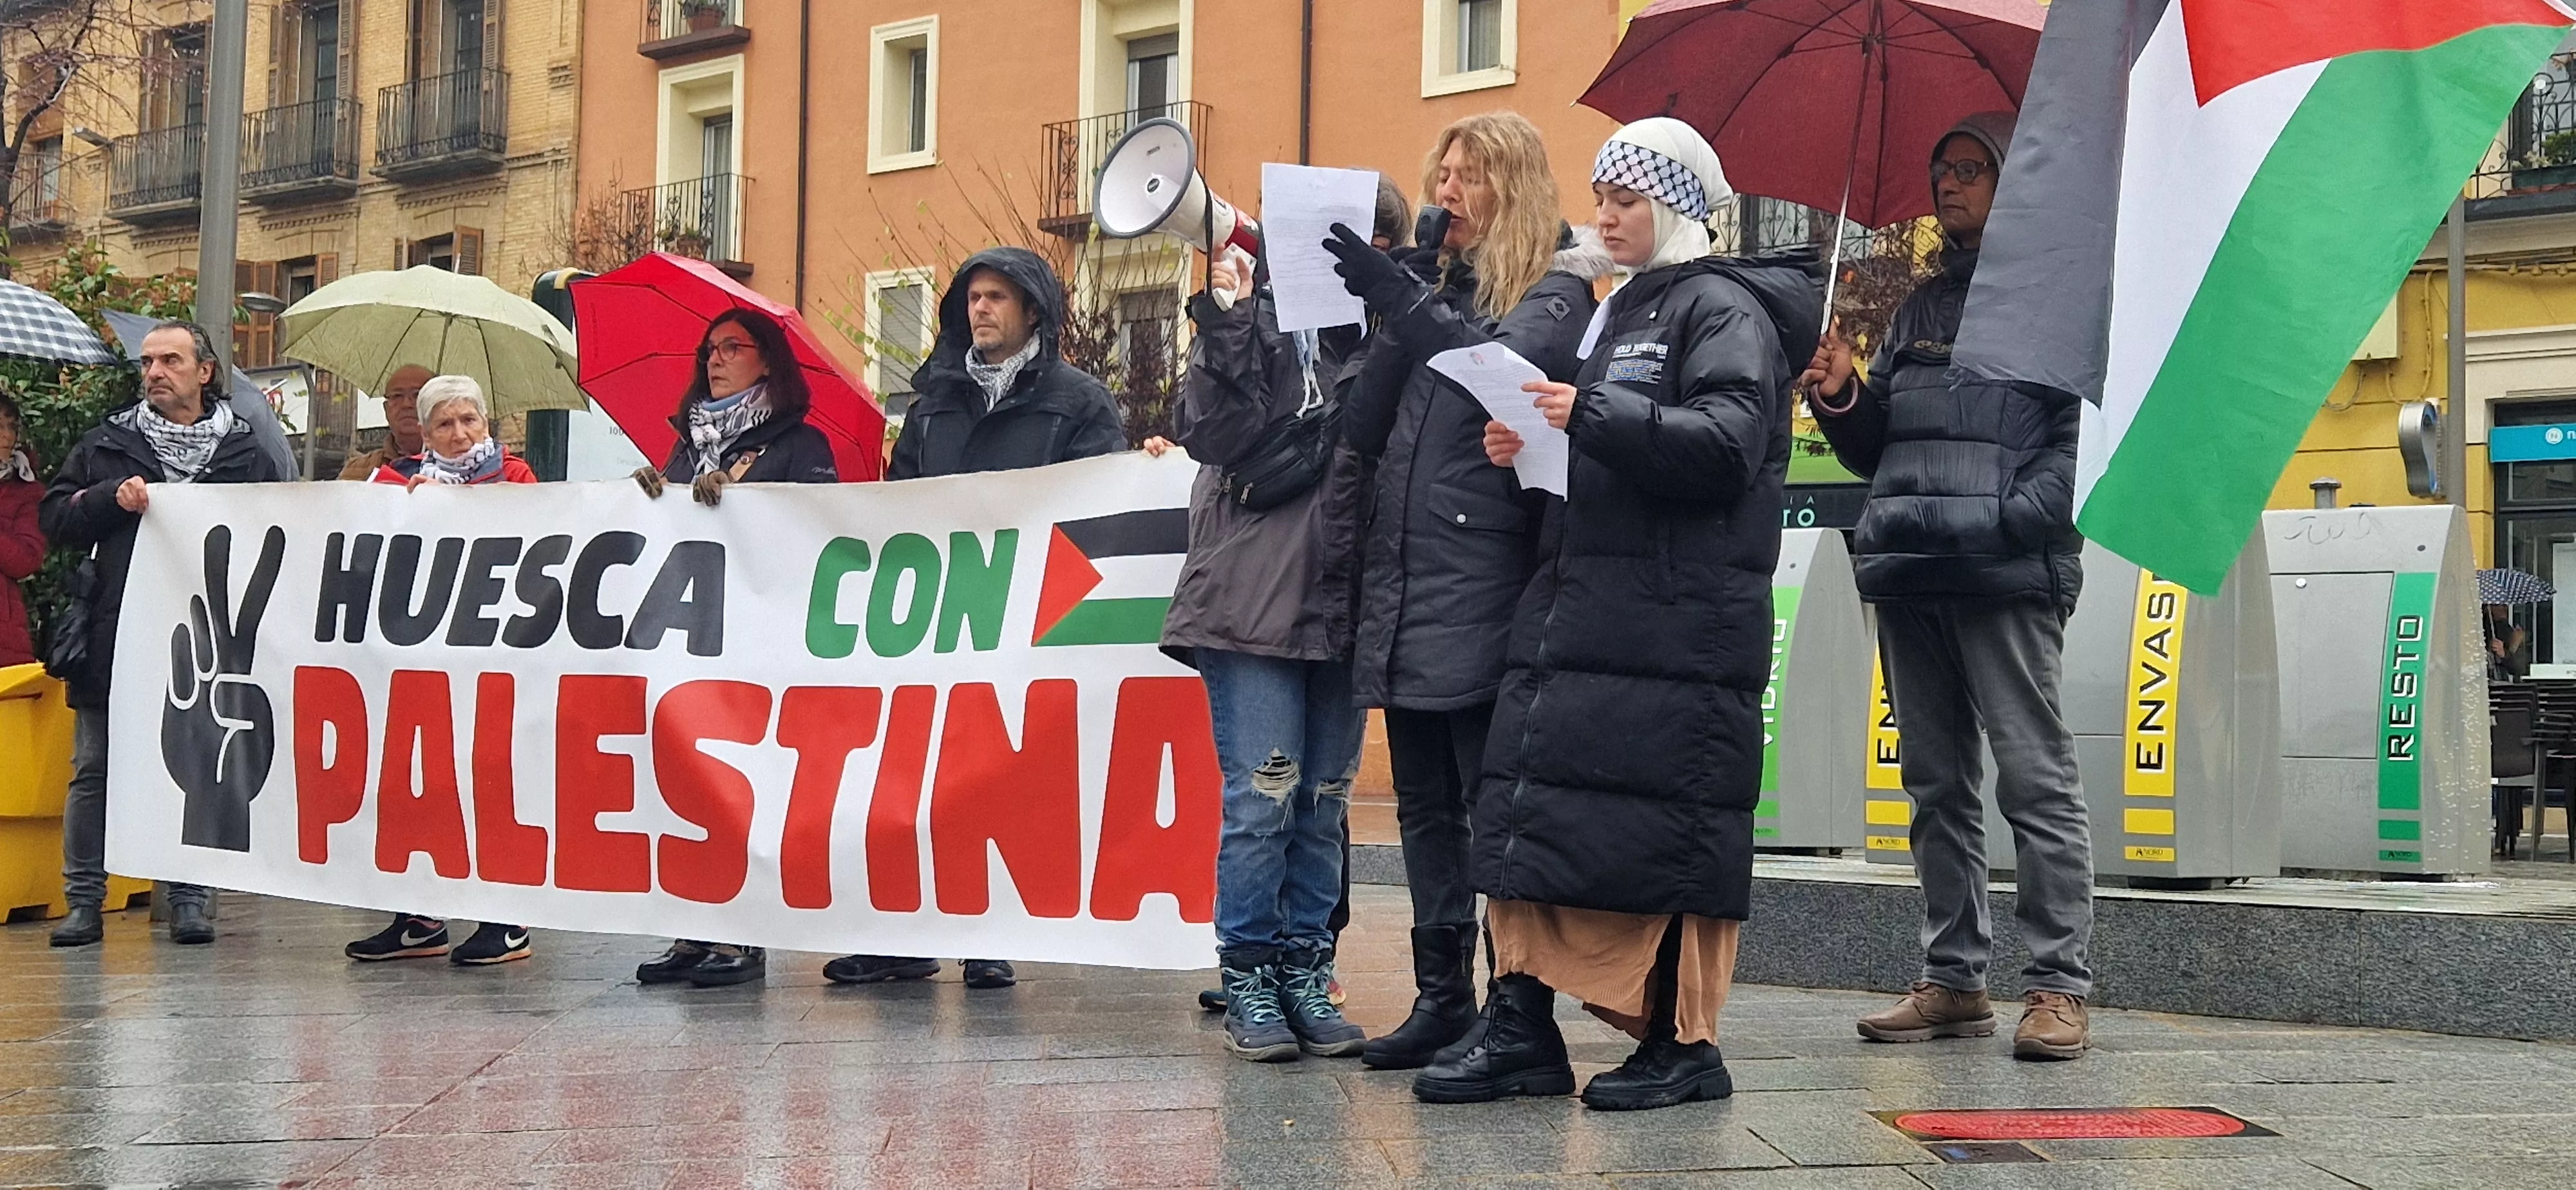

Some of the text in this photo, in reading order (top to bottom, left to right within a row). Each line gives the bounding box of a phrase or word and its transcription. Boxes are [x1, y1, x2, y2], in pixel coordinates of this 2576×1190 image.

[314, 528, 1019, 659] HUESCA CON
[1877, 685, 1901, 767] EN
[2135, 572, 2176, 771] ENVAS
[2387, 615, 2423, 761] RESTO
[293, 665, 1224, 923] PALESTINA
